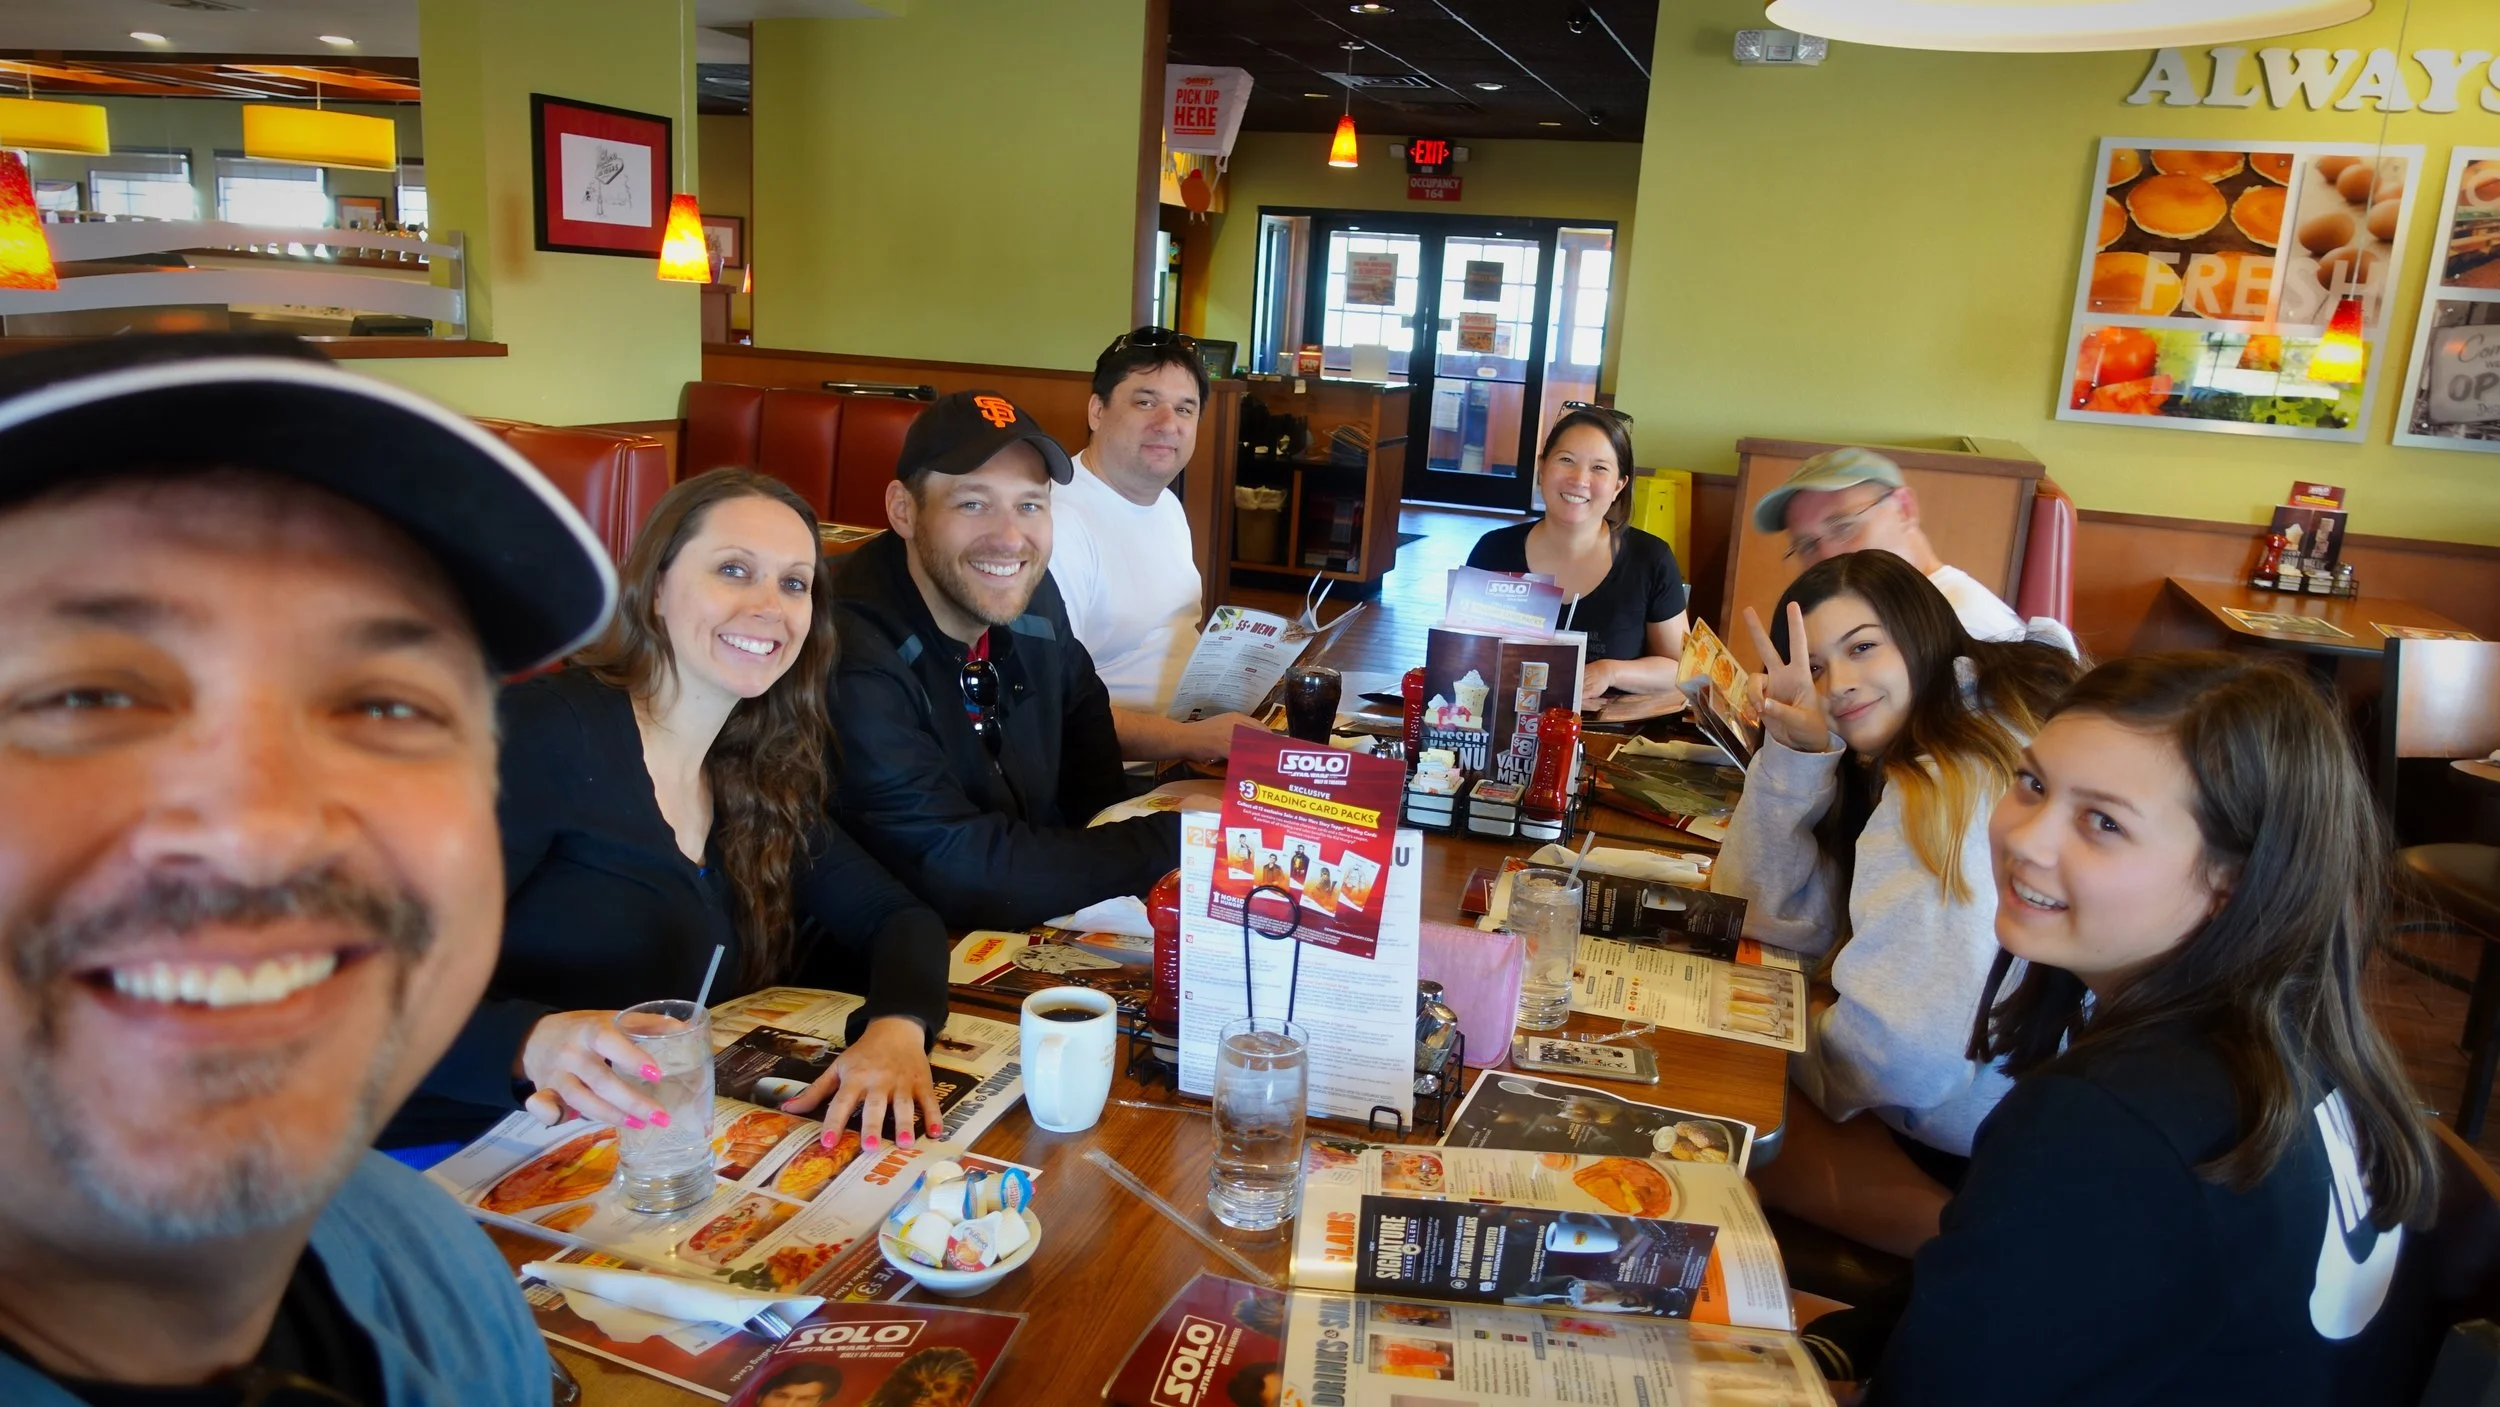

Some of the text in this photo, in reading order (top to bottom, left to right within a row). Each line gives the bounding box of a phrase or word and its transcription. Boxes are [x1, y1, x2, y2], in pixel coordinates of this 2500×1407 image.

[1176, 88, 1220, 105] PICK UP
[1173, 106, 1218, 127] HERE
[1415, 140, 1446, 165] EXIT
[1410, 177, 1459, 189] OCCUPANCY
[1424, 189, 1444, 199] 164
[2139, 252, 2382, 326] FRESH
[2448, 372, 2500, 402] OP
[1489, 582, 1527, 594] SOLO
[1235, 619, 1278, 637] 55+ MENU
[1519, 692, 1538, 709] $4
[1520, 715, 1538, 733] $6
[1429, 730, 1490, 748] DESSERT
[1513, 737, 1534, 756] $8
[1283, 755, 1344, 773] SOLO
[1496, 752, 1534, 773] VALU
[1497, 768, 1532, 786] MEN
[1238, 781, 1375, 824] $3 TRADING CARD PACKS
[1288, 784, 1331, 800] EXCLUSIVE
[967, 938, 1003, 962] Denny's
[975, 1062, 1022, 1097] DRINKS
[1376, 1214, 1407, 1280] SIGNATURE
[1404, 1219, 1417, 1278] DINER BLEND
[1458, 1216, 1478, 1278] 100% ARABICA BEANS
[1483, 1226, 1499, 1257] HARVESTED
[1450, 1253, 1459, 1277] COLOMBIAN
[1479, 1261, 1493, 1280] GROWN
[860, 1281, 882, 1295] $3
[787, 1325, 910, 1347] SOLO
[1324, 1329, 1339, 1339] &
[798, 1344, 839, 1353] STAR
[1163, 1323, 1215, 1405] SOLO
[1199, 1344, 1222, 1394] STAR WARS
[1312, 1339, 1349, 1407] DRINKS
